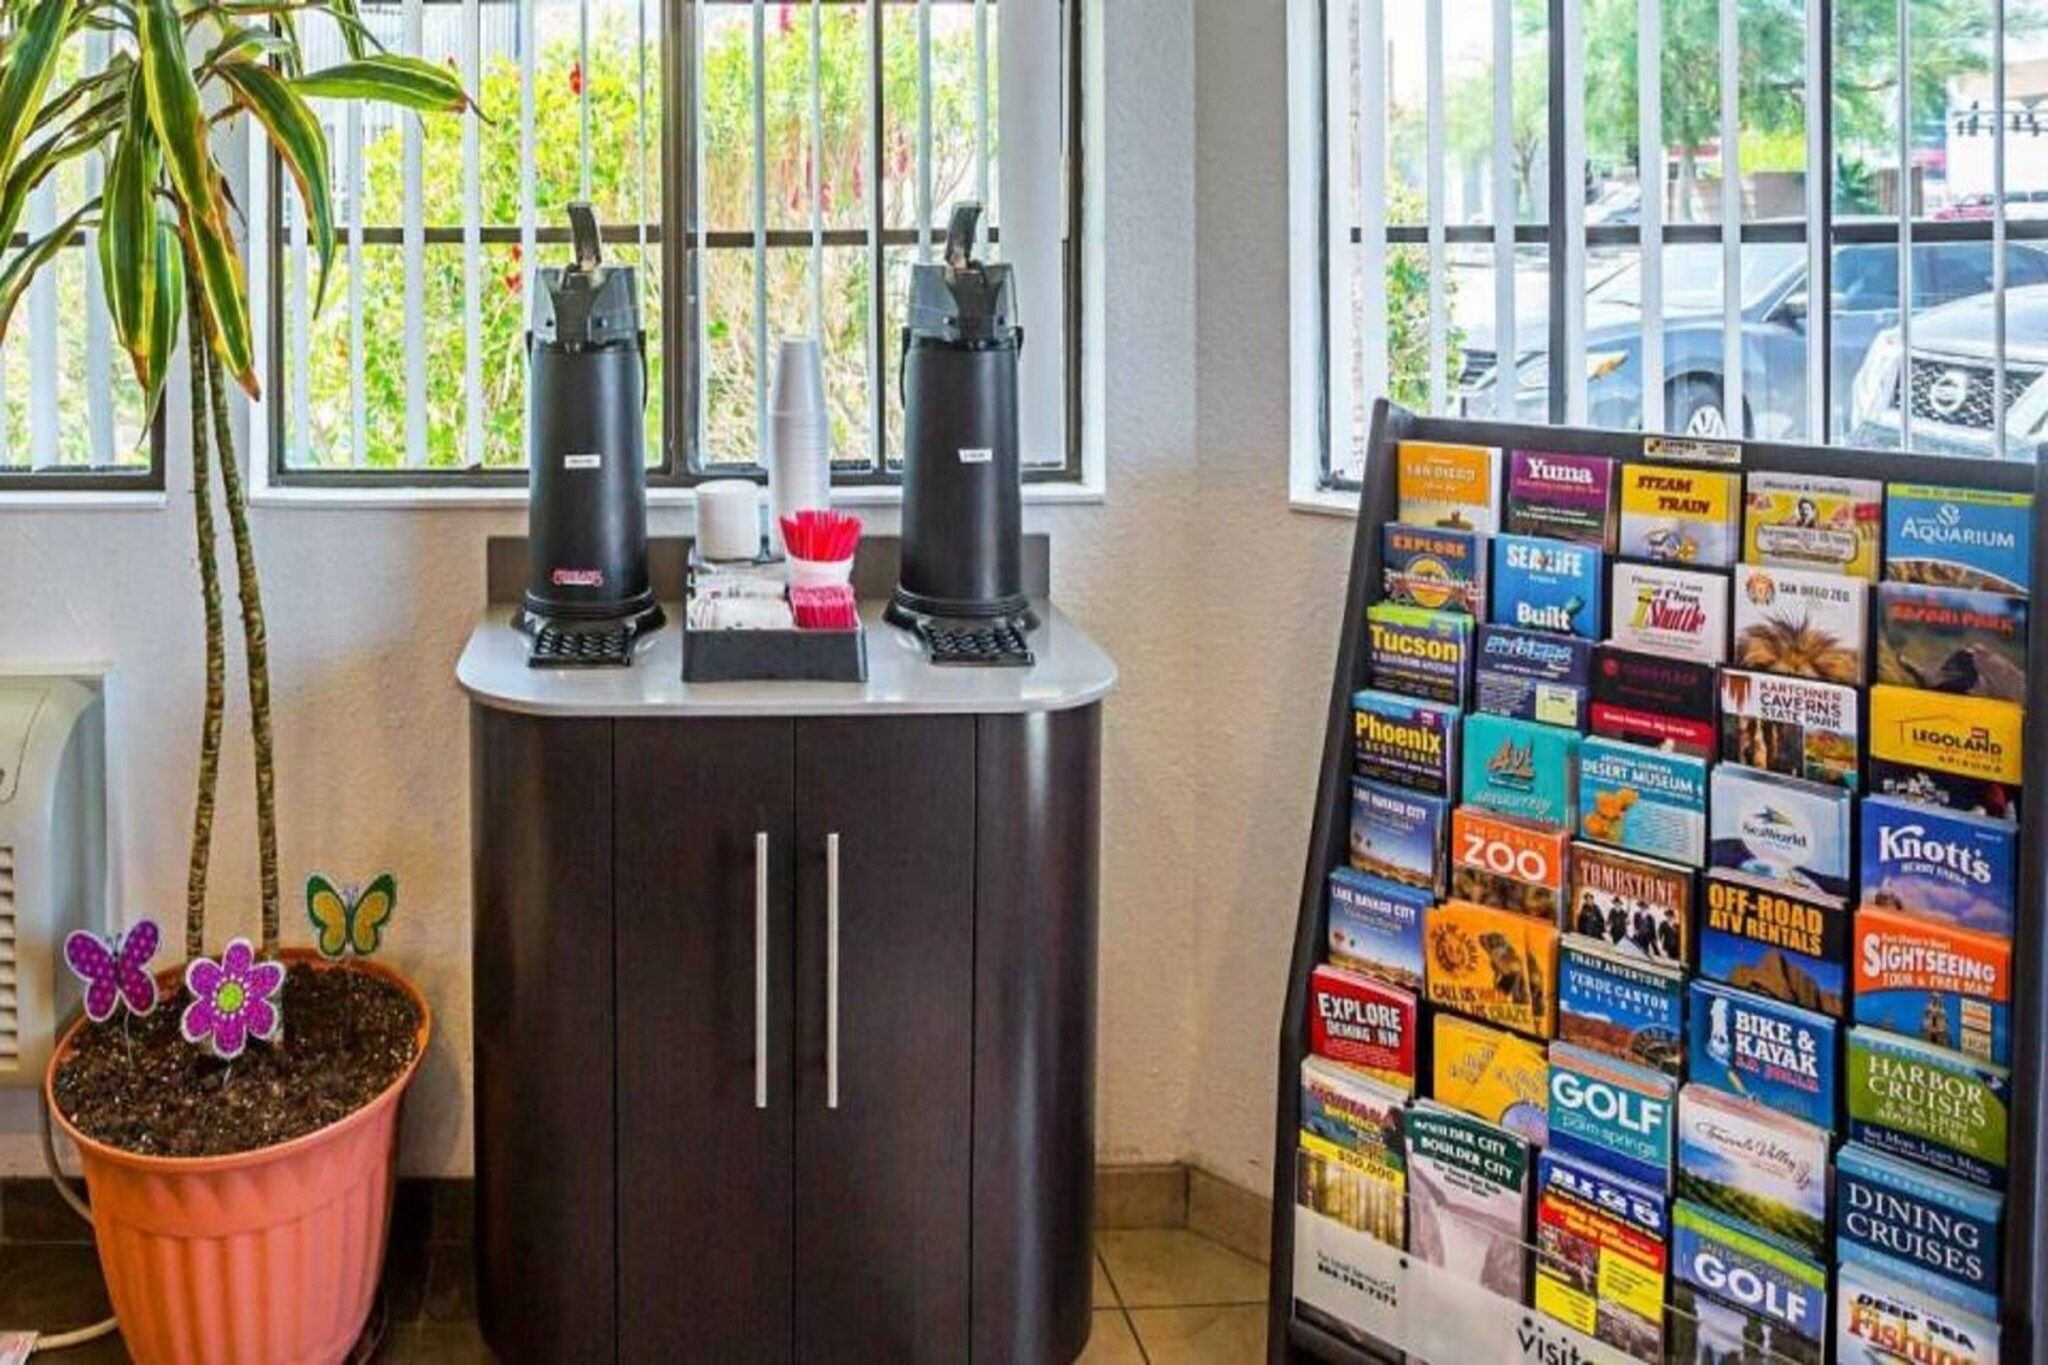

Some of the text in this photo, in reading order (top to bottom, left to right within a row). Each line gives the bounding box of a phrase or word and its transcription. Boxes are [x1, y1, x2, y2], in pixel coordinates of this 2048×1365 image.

[1527, 457, 1594, 485] Yuma
[1637, 474, 1694, 493] STEAM
[1657, 495, 1713, 514] TRAIN
[1392, 533, 1466, 558] EXPLORE
[1901, 518, 2015, 549] AQUARIUM
[1368, 624, 1460, 663] Tucson
[1759, 680, 1842, 701] KARTCHNER
[1759, 692, 1842, 718] CAVERNS
[1355, 711, 1442, 754] Phoenix
[1761, 706, 1841, 729] STATE PARK
[1912, 727, 2003, 756] LEGOLAND
[1582, 758, 1694, 794] DESERT MUSEUM
[1463, 832, 1548, 882] ZOO
[1877, 824, 1992, 884] Knott's
[1331, 884, 1352, 904] LAKE
[1354, 889, 1393, 915] HAVASU
[1393, 903, 1416, 923] CITY
[1579, 860, 1677, 906] TOMBSTONE
[1708, 883, 1824, 936] OFF-ROAD
[1709, 908, 1824, 957] ATV RENTALS
[1570, 951, 1668, 990] TRAIN ADVENTURE
[1862, 933, 1997, 984] SIGHTSEEING
[1569, 970, 1669, 1011] VERDE CANYON
[1317, 992, 1403, 1034] EXPLORE
[1326, 1021, 1371, 1043] DEMING
[1734, 1009, 1816, 1054] BIKE &
[1734, 1032, 1819, 1080] KAYAK
[1868, 1075, 1987, 1128] CRUISES
[1869, 1054, 1984, 1109] HARBOR
[1551, 1072, 1663, 1135] GOLF
[1420, 1136, 1514, 1180] BOULDER CITY
[1478, 1136, 1507, 1158] CITY
[1848, 1182, 1980, 1250] DINING
[1846, 1212, 1984, 1281] CRUISES
[1693, 1252, 1808, 1324] GOLF
[1857, 1292, 1976, 1351] DEEP SEA
[1516, 1325, 1595, 1365] visit
